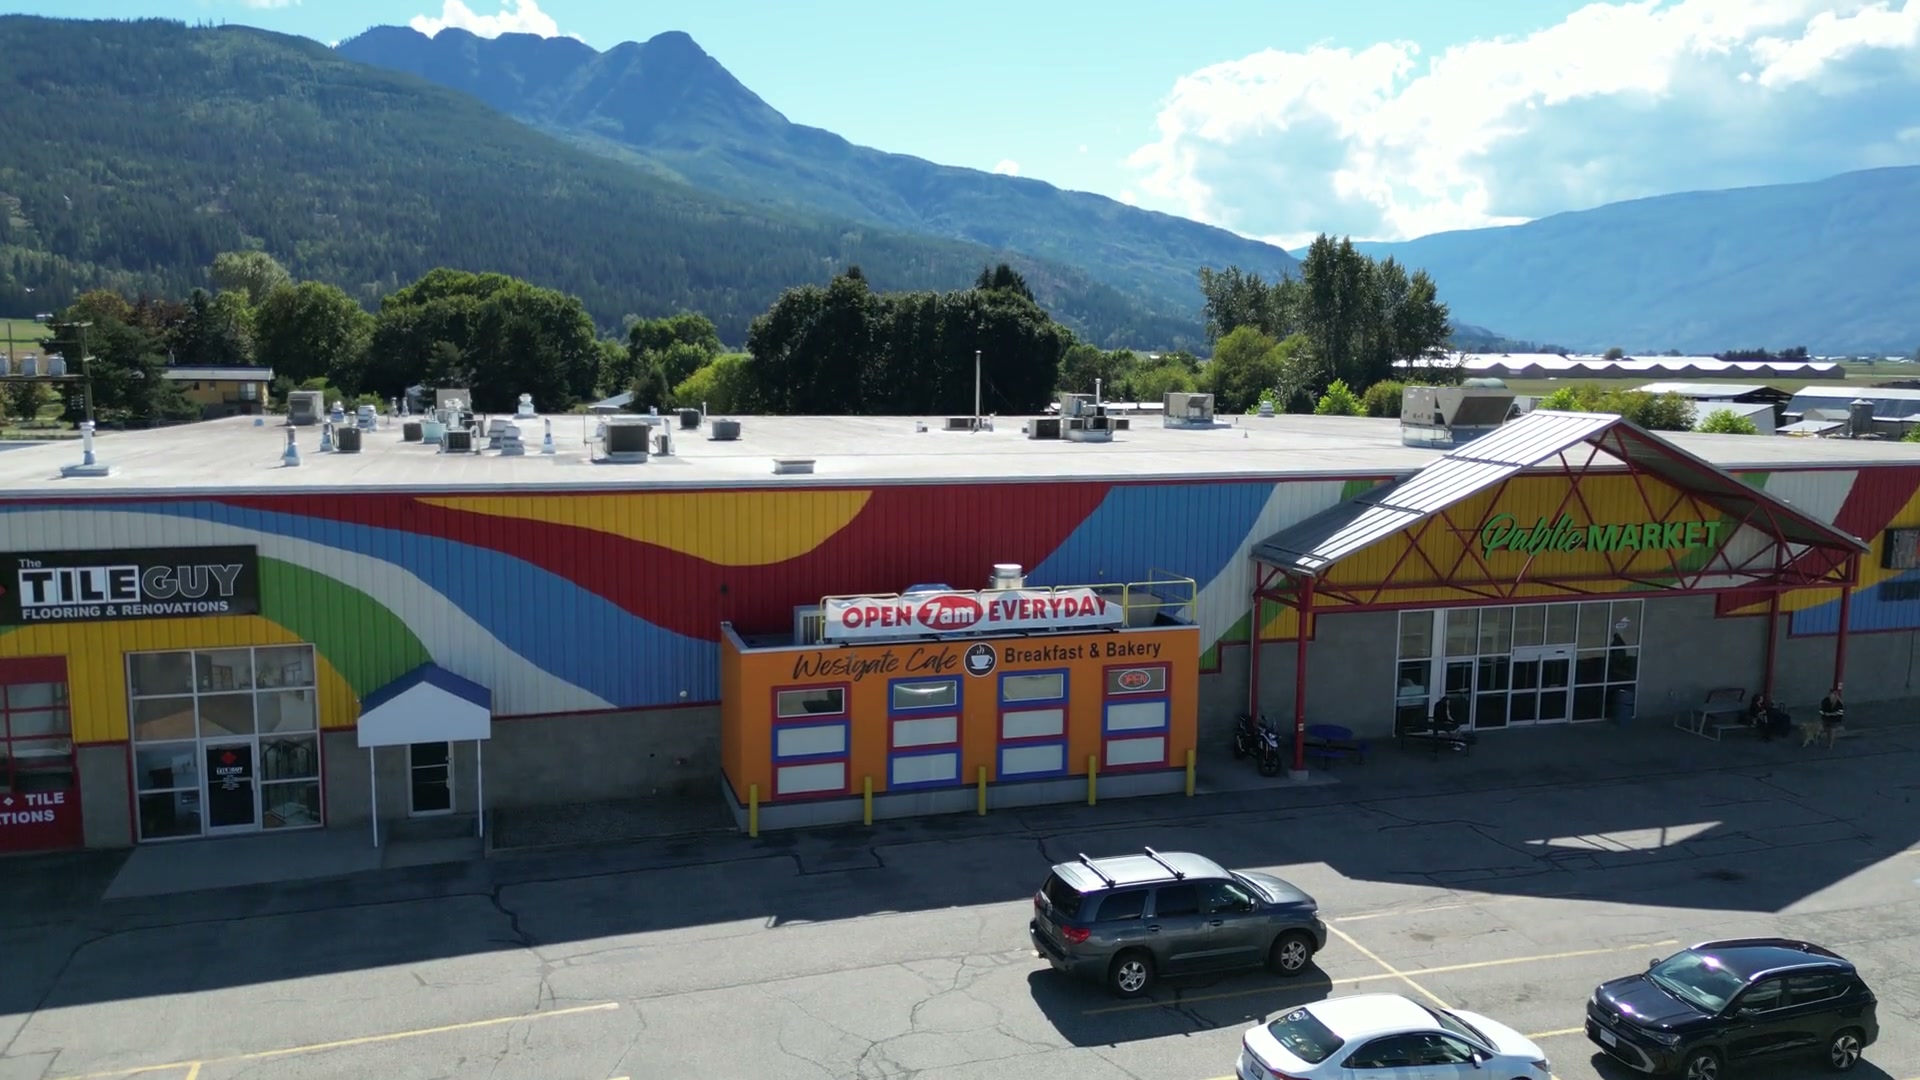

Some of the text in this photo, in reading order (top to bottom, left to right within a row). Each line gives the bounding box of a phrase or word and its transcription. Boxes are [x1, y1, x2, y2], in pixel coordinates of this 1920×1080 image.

[1481, 512, 1721, 560] Public MARKET
[18, 558, 42, 568] The
[20, 564, 243, 605] TILE GUY
[22, 600, 229, 620] FLOORING & RENOVATIONS
[842, 595, 1107, 629] OPEN 7am EVERYDAY
[1004, 640, 1162, 664] Breakfast & Bakery
[792, 647, 957, 681] Westgate Cafe
[1122, 673, 1148, 686] OPEN
[25, 791, 65, 806] TILE
[0, 809, 55, 825] TIONS
